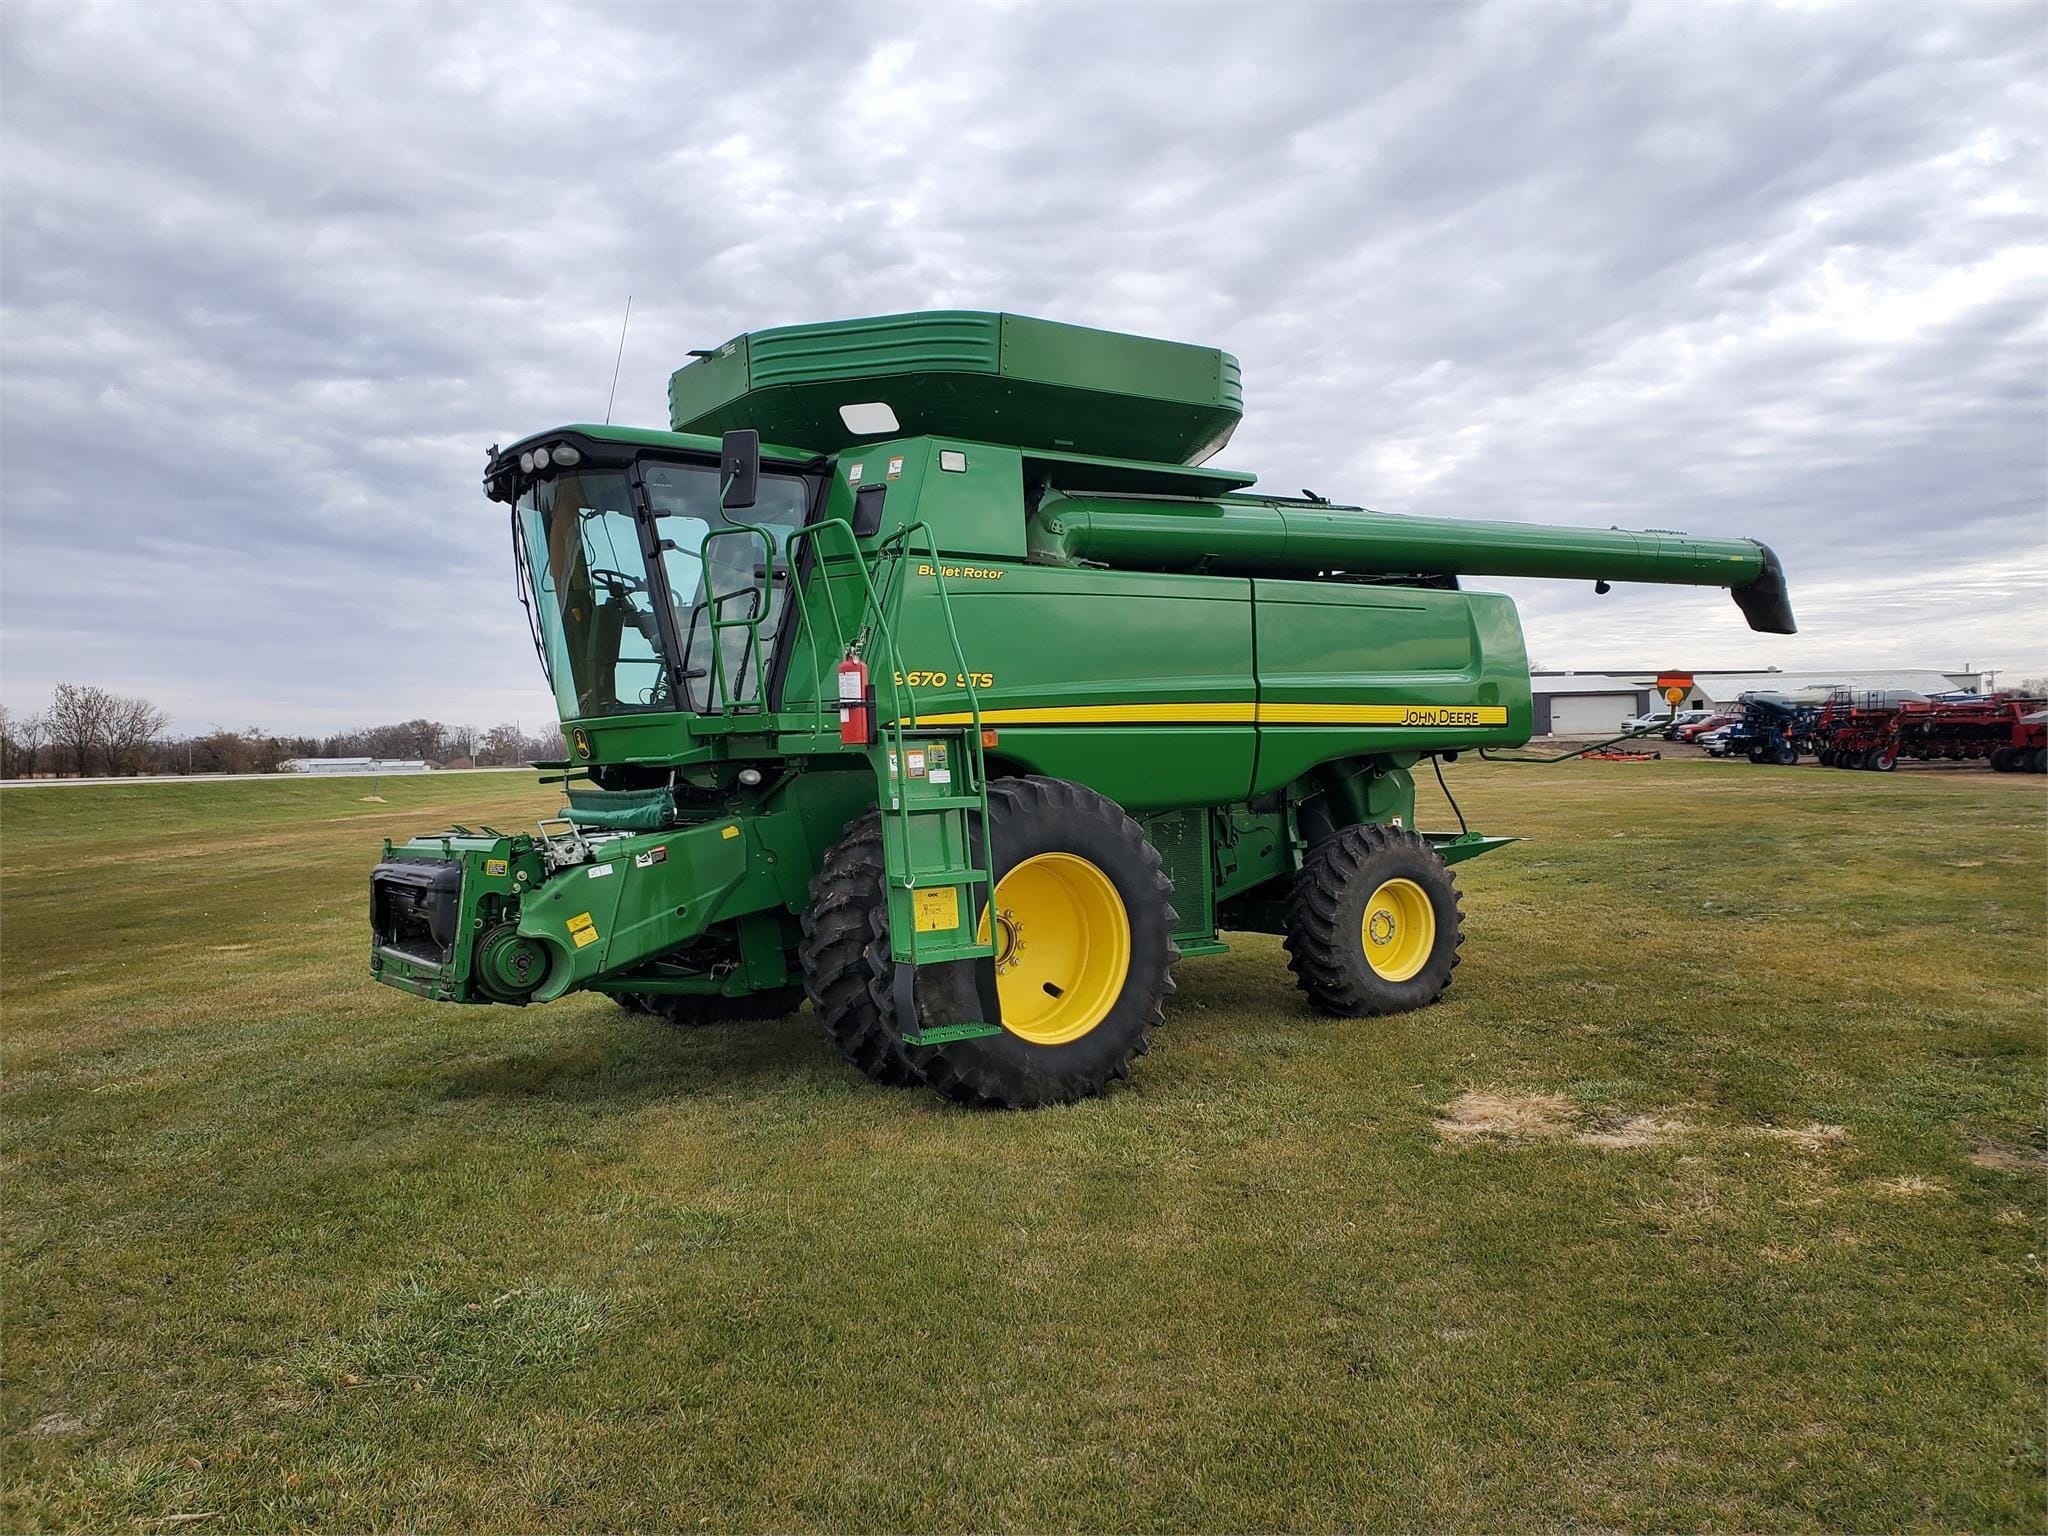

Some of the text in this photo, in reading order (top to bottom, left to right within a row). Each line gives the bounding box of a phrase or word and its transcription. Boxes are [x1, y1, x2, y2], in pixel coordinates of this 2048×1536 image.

[963, 567, 1004, 579] Rotor
[956, 672, 993, 688] STS
[1401, 709, 1480, 724] JOHN DEERE
